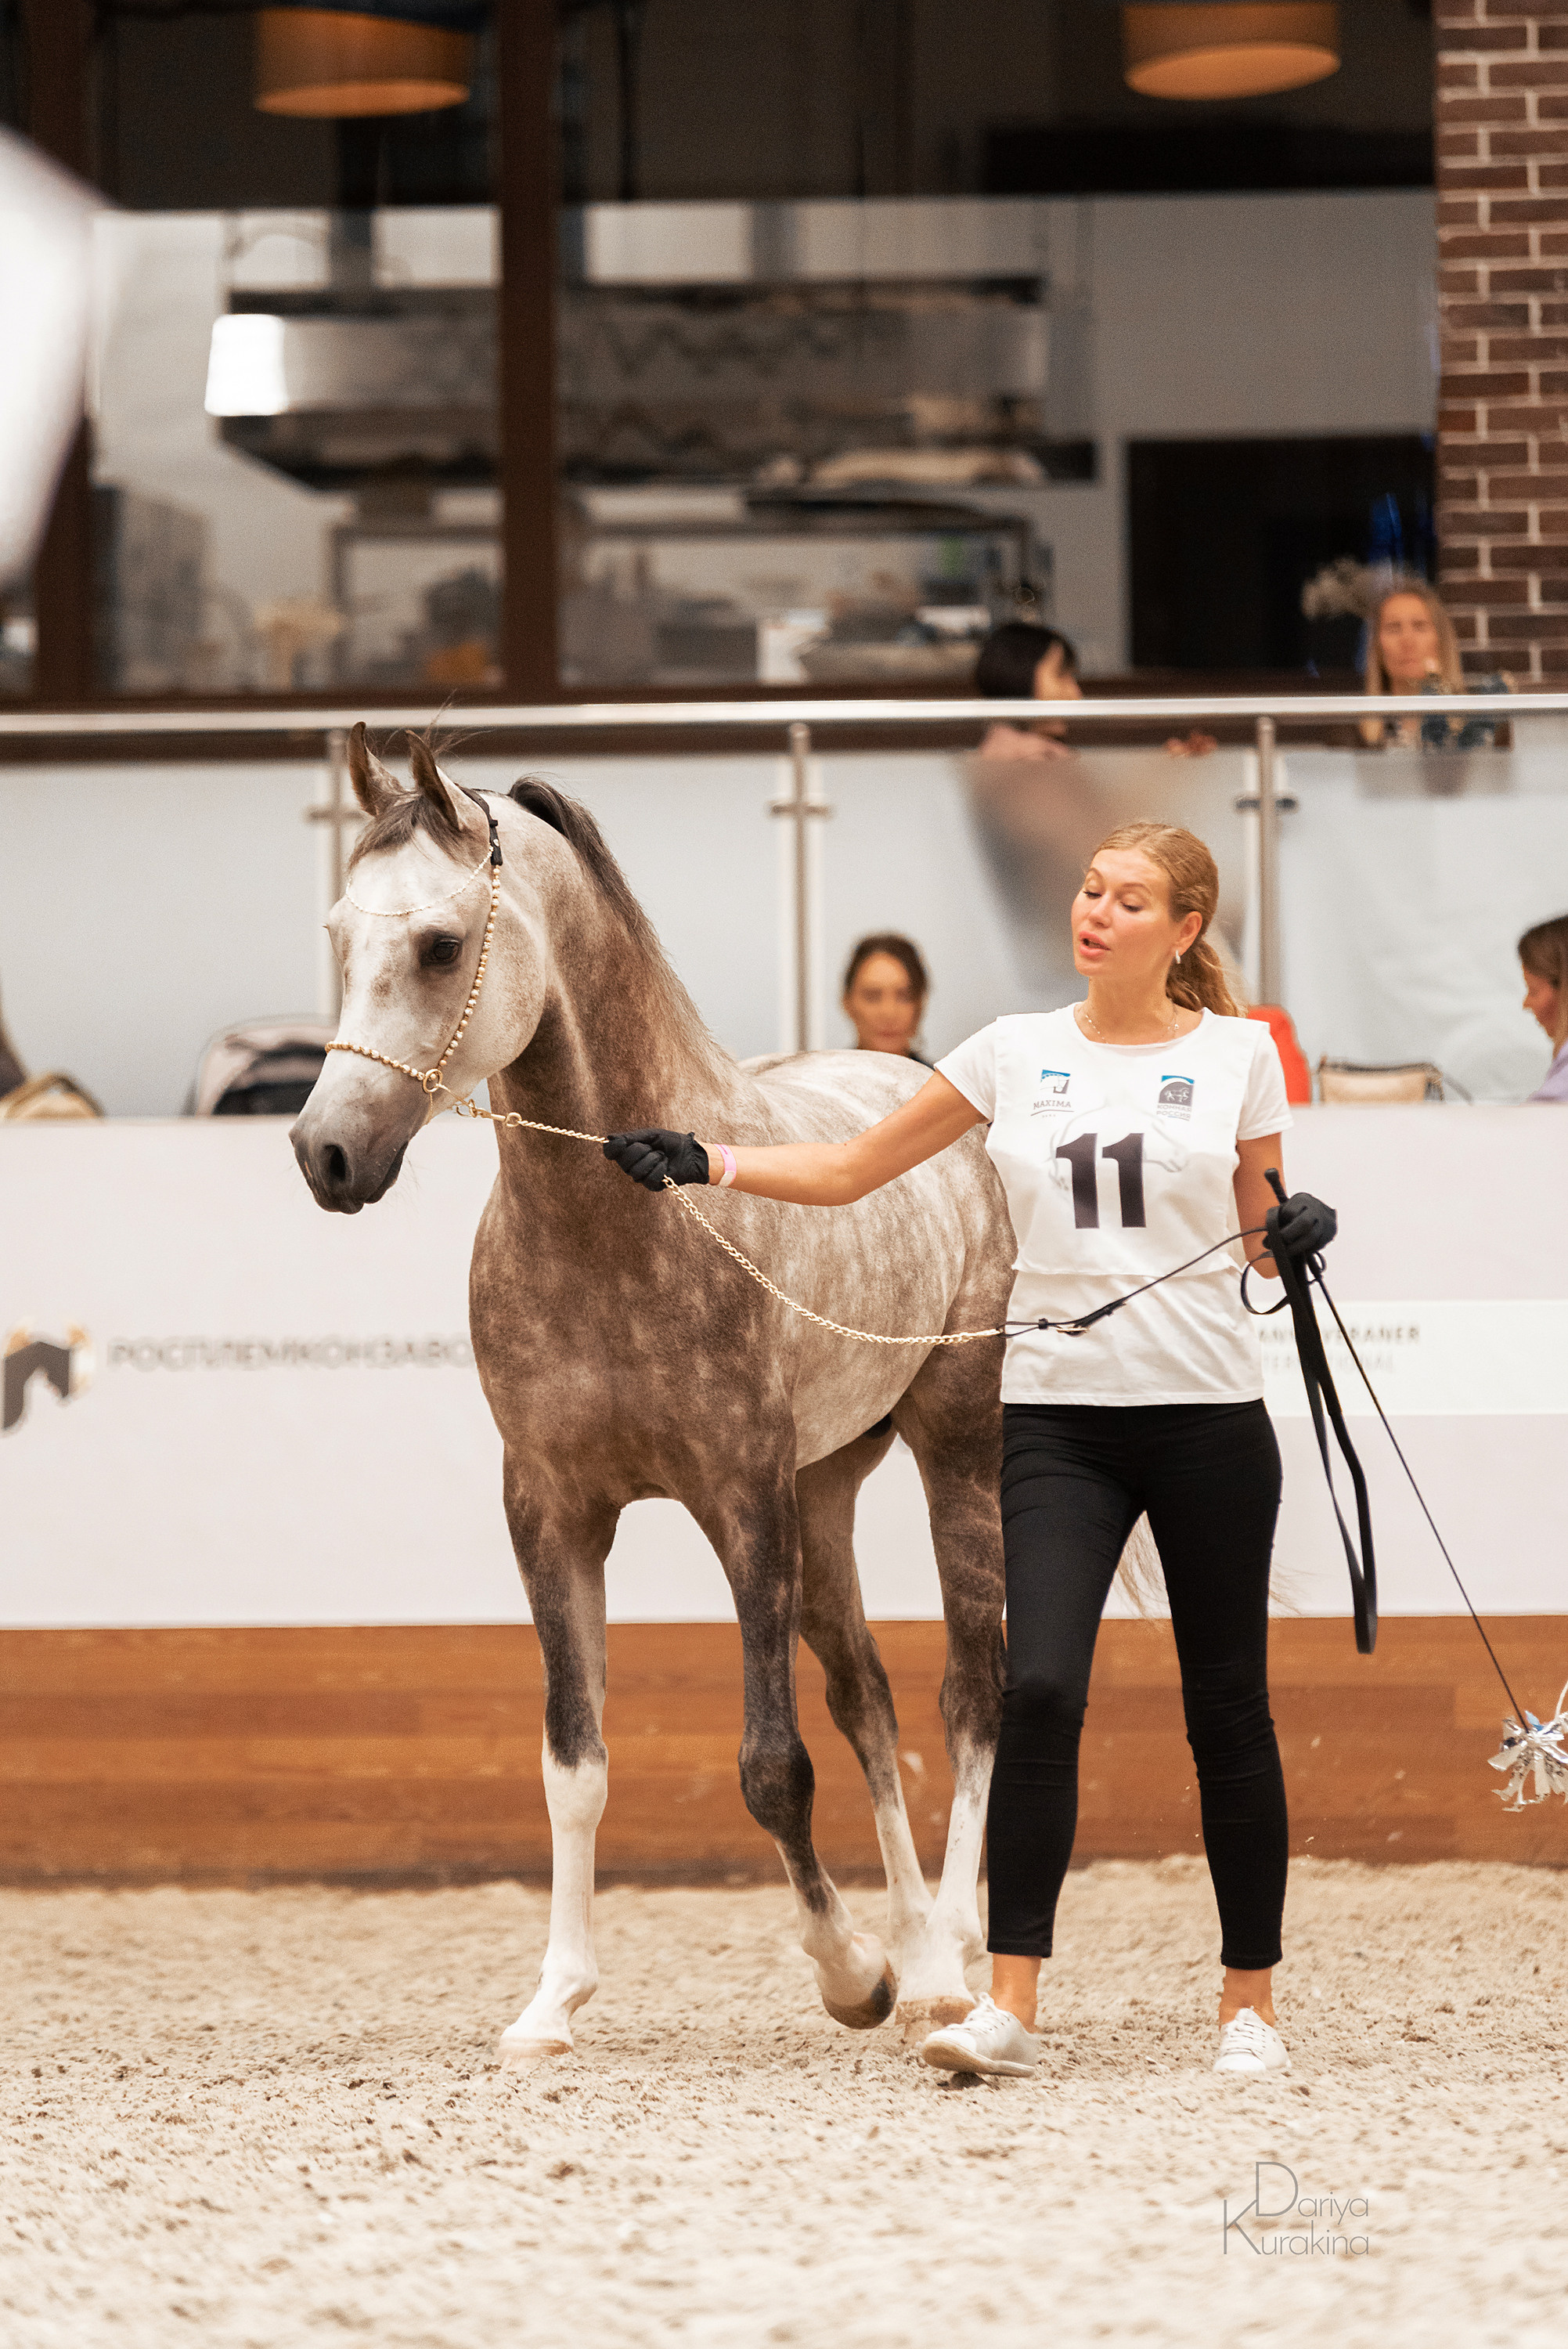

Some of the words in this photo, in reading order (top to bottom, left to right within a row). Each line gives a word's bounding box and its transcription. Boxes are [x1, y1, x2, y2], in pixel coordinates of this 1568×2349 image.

[1033, 1099, 1072, 1110] MAXIMA
[1056, 1133, 1146, 1229] 11
[108, 1336, 472, 1371] РОСПЛЕМКОНЗАВО
